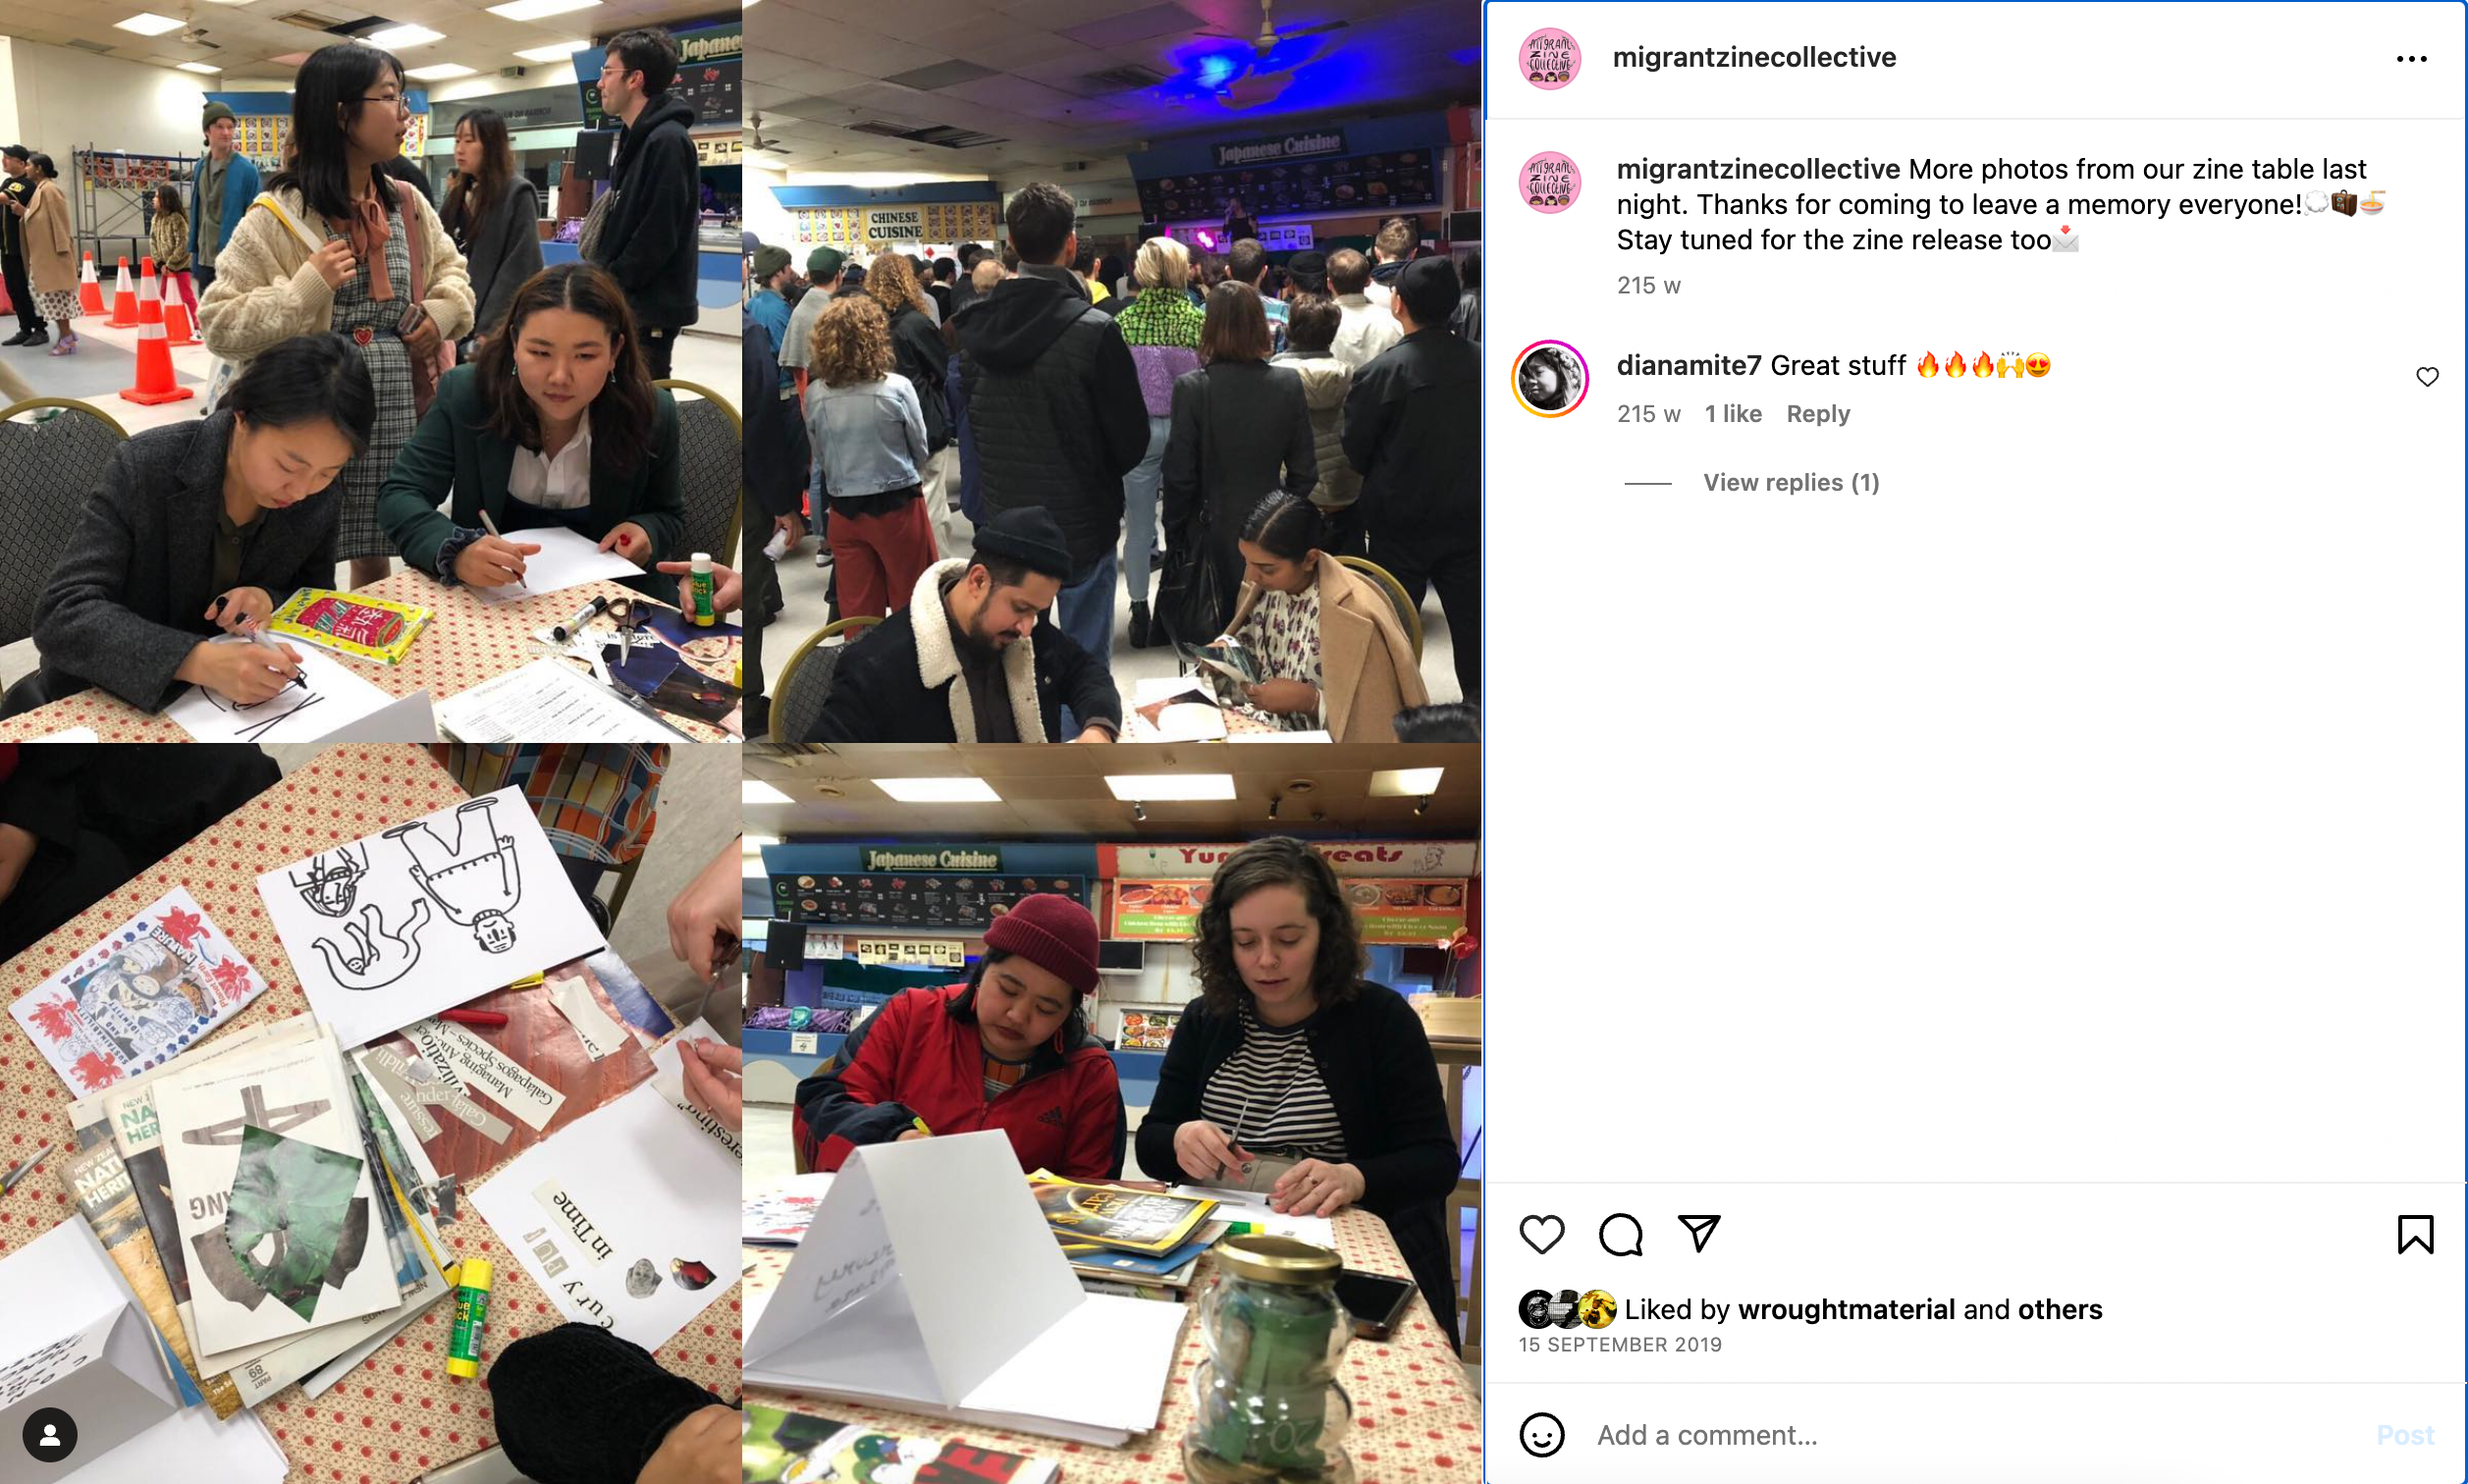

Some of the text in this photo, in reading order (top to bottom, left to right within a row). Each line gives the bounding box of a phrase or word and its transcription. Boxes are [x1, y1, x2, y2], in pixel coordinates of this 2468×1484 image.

[1218, 134, 1341, 166] Japanese Cuisine
[871, 212, 919, 224] CHINESE
[869, 226, 923, 238] CUISINE
[868, 850, 997, 871] Japanese Cuisine
[149, 926, 196, 965] NATURE
[207, 982, 229, 1008] Planet
[106, 1021, 121, 1037] AND
[108, 1000, 139, 1034] IDENTITY
[77, 1006, 130, 1065] SUSTAINABILITY
[456, 1034, 495, 1066] Species
[458, 1056, 513, 1099] Managing
[495, 1059, 553, 1107] Galápagos
[123, 1097, 143, 1109] NEW
[74, 1159, 94, 1176] NEW
[553, 1192, 614, 1260] in Time
[248, 1365, 263, 1378] 89
[255, 1375, 272, 1390] PART
